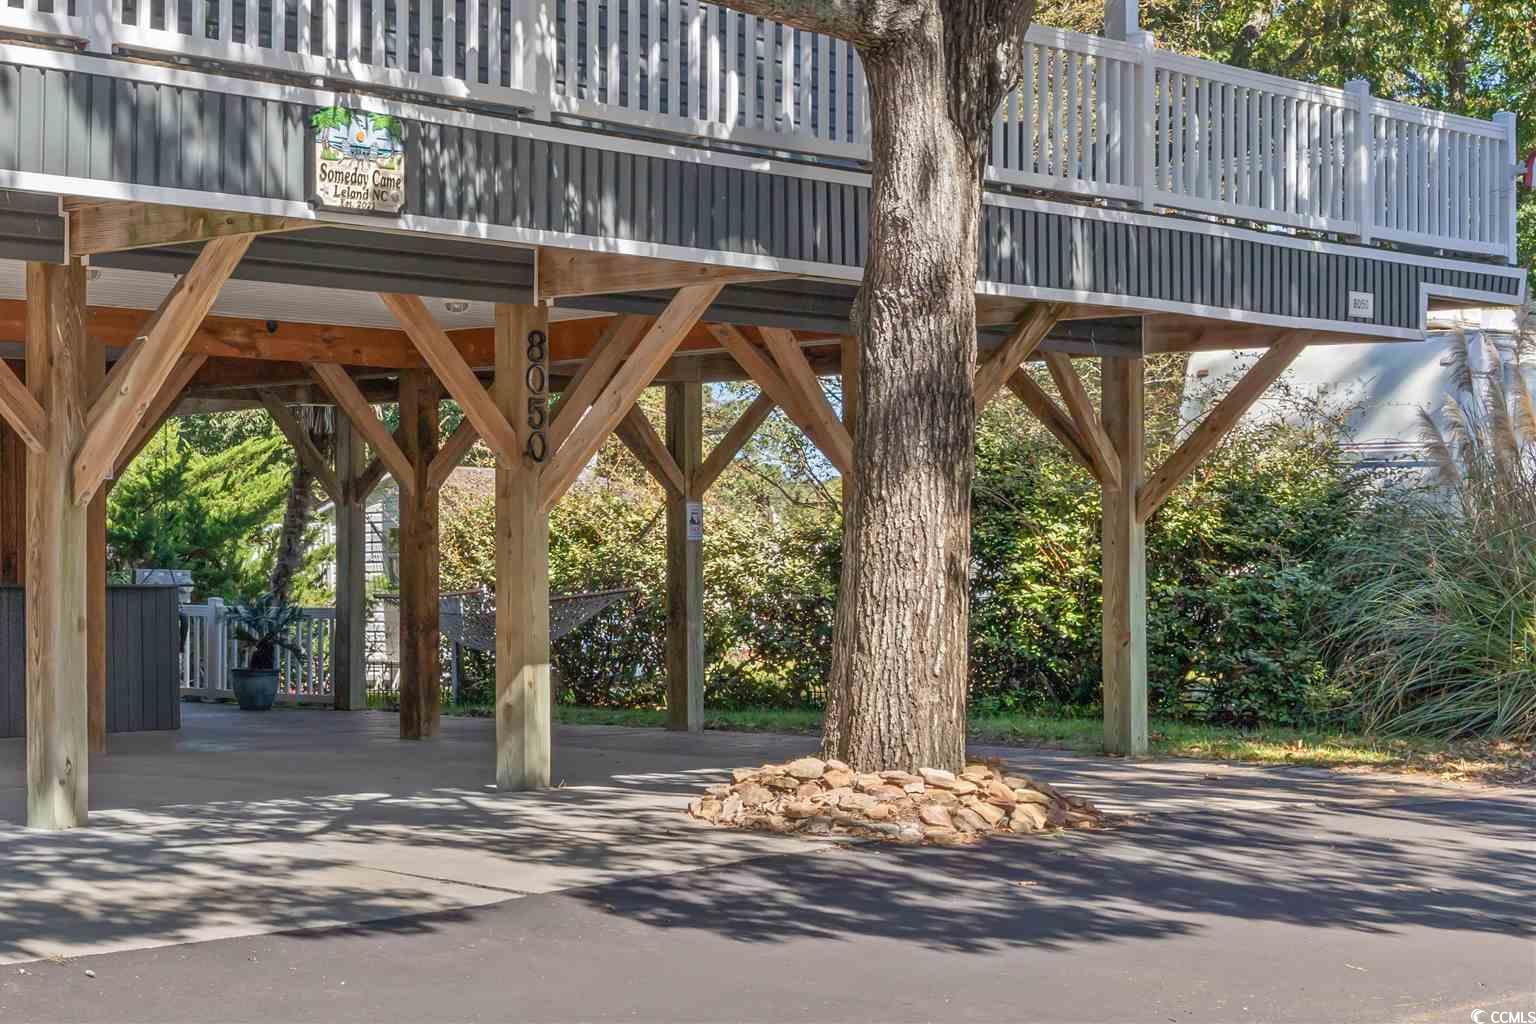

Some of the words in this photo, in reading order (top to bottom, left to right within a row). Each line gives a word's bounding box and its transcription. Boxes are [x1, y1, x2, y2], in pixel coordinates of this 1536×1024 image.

[320, 163, 369, 190] Someday
[373, 170, 401, 189] Came
[333, 184, 369, 201] Leland
[372, 189, 388, 202] NC
[526, 330, 546, 463] 8050
